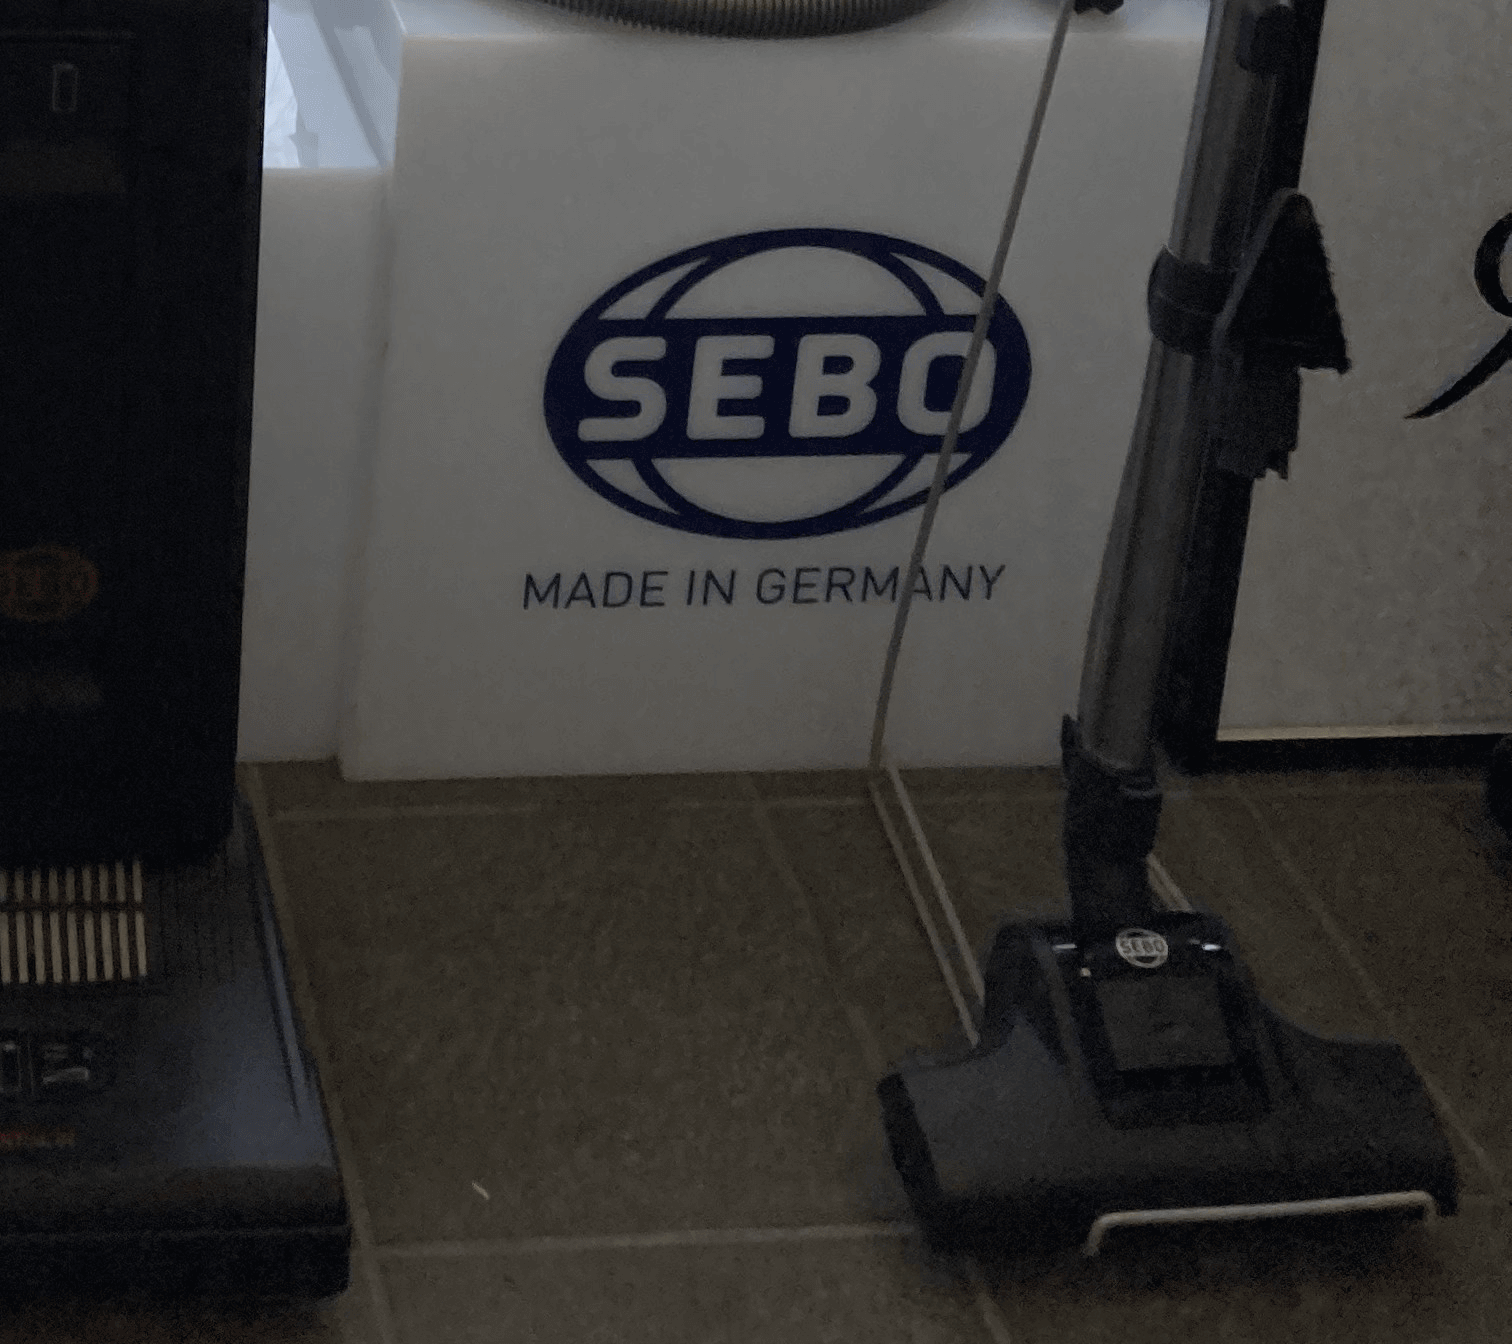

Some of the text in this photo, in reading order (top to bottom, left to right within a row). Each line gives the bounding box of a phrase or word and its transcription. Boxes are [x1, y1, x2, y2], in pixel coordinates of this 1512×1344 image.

[577, 330, 998, 443] SEBO
[523, 564, 1006, 610] MADE IN GERMANY
